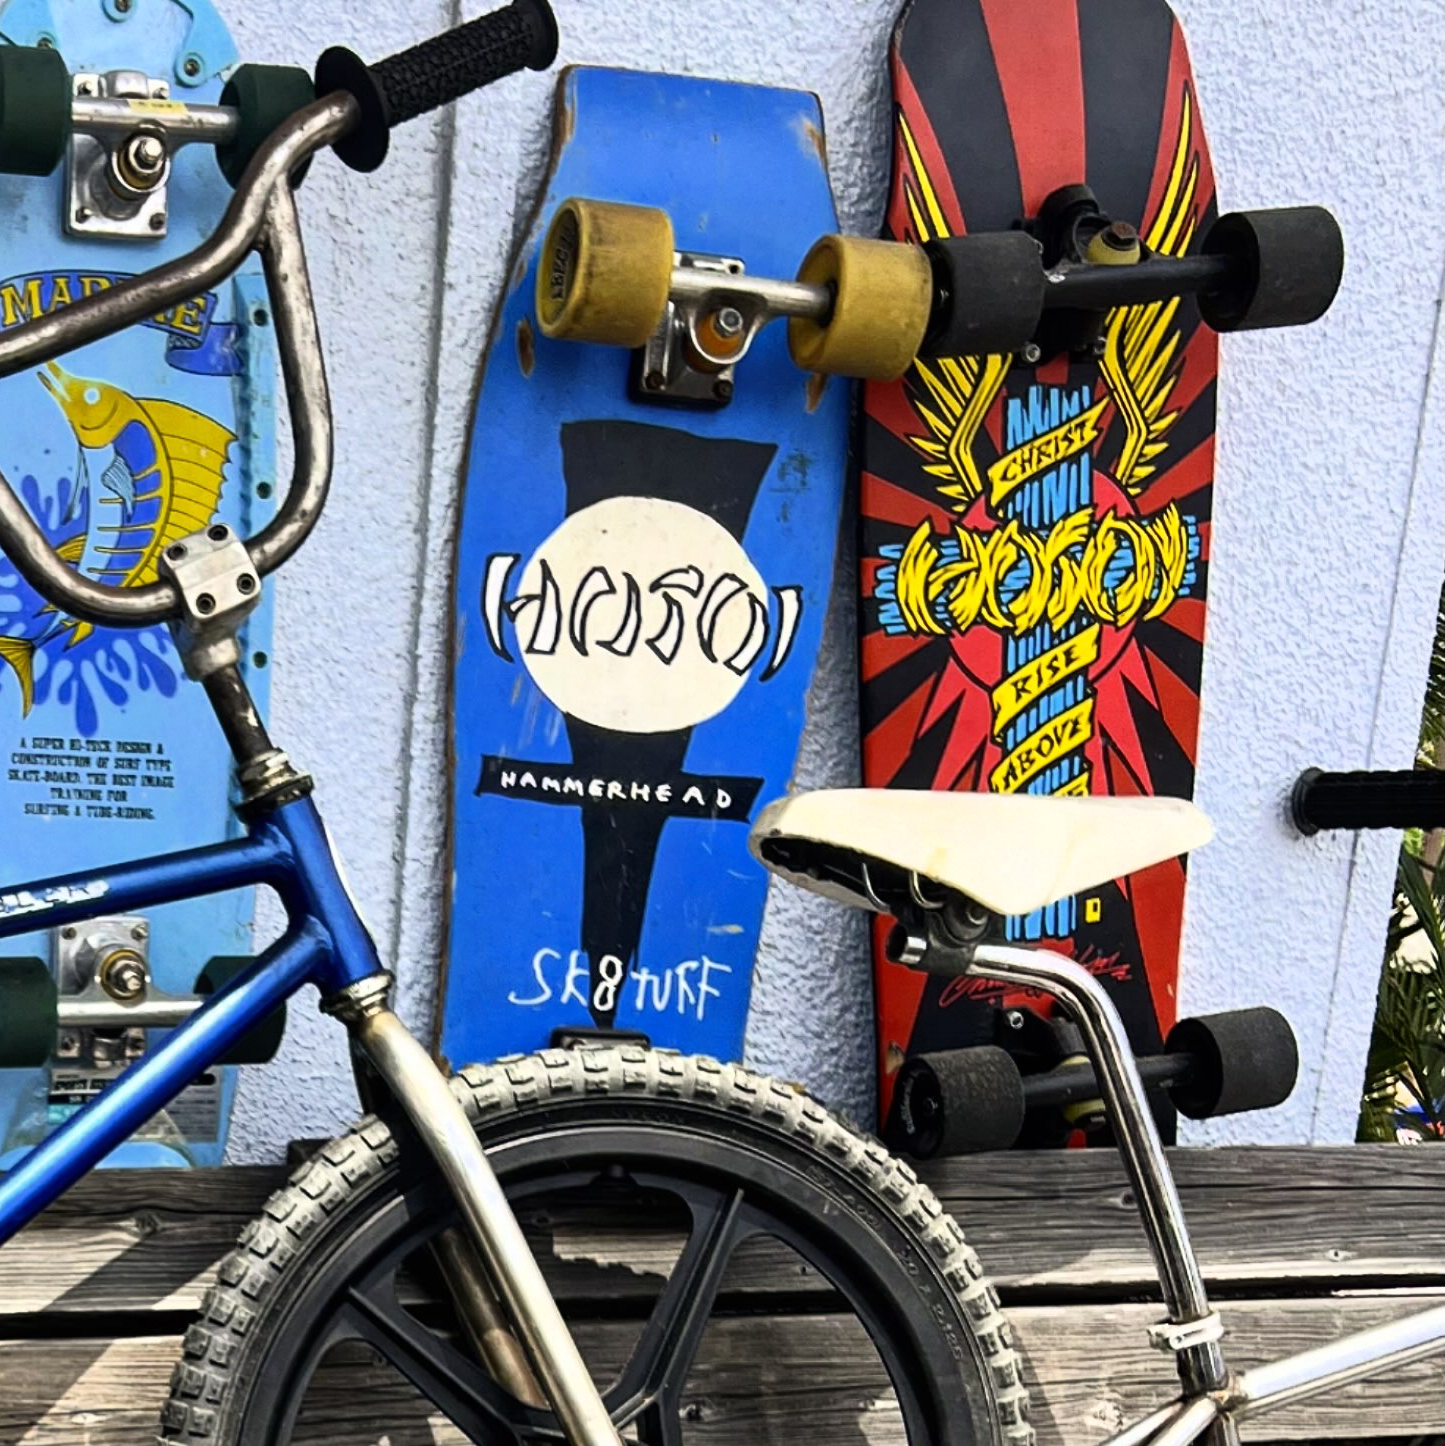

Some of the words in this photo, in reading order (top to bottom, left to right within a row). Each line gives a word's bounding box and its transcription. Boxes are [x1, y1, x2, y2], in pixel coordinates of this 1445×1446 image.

[0, 275, 205, 336] MAE
[1000, 420, 1092, 484] CHRIST
[480, 551, 803, 682] HOSOI
[1013, 643, 1078, 703] RISE
[1001, 714, 1084, 792] ABOVE
[500, 771, 733, 809] HAMMERHEAD
